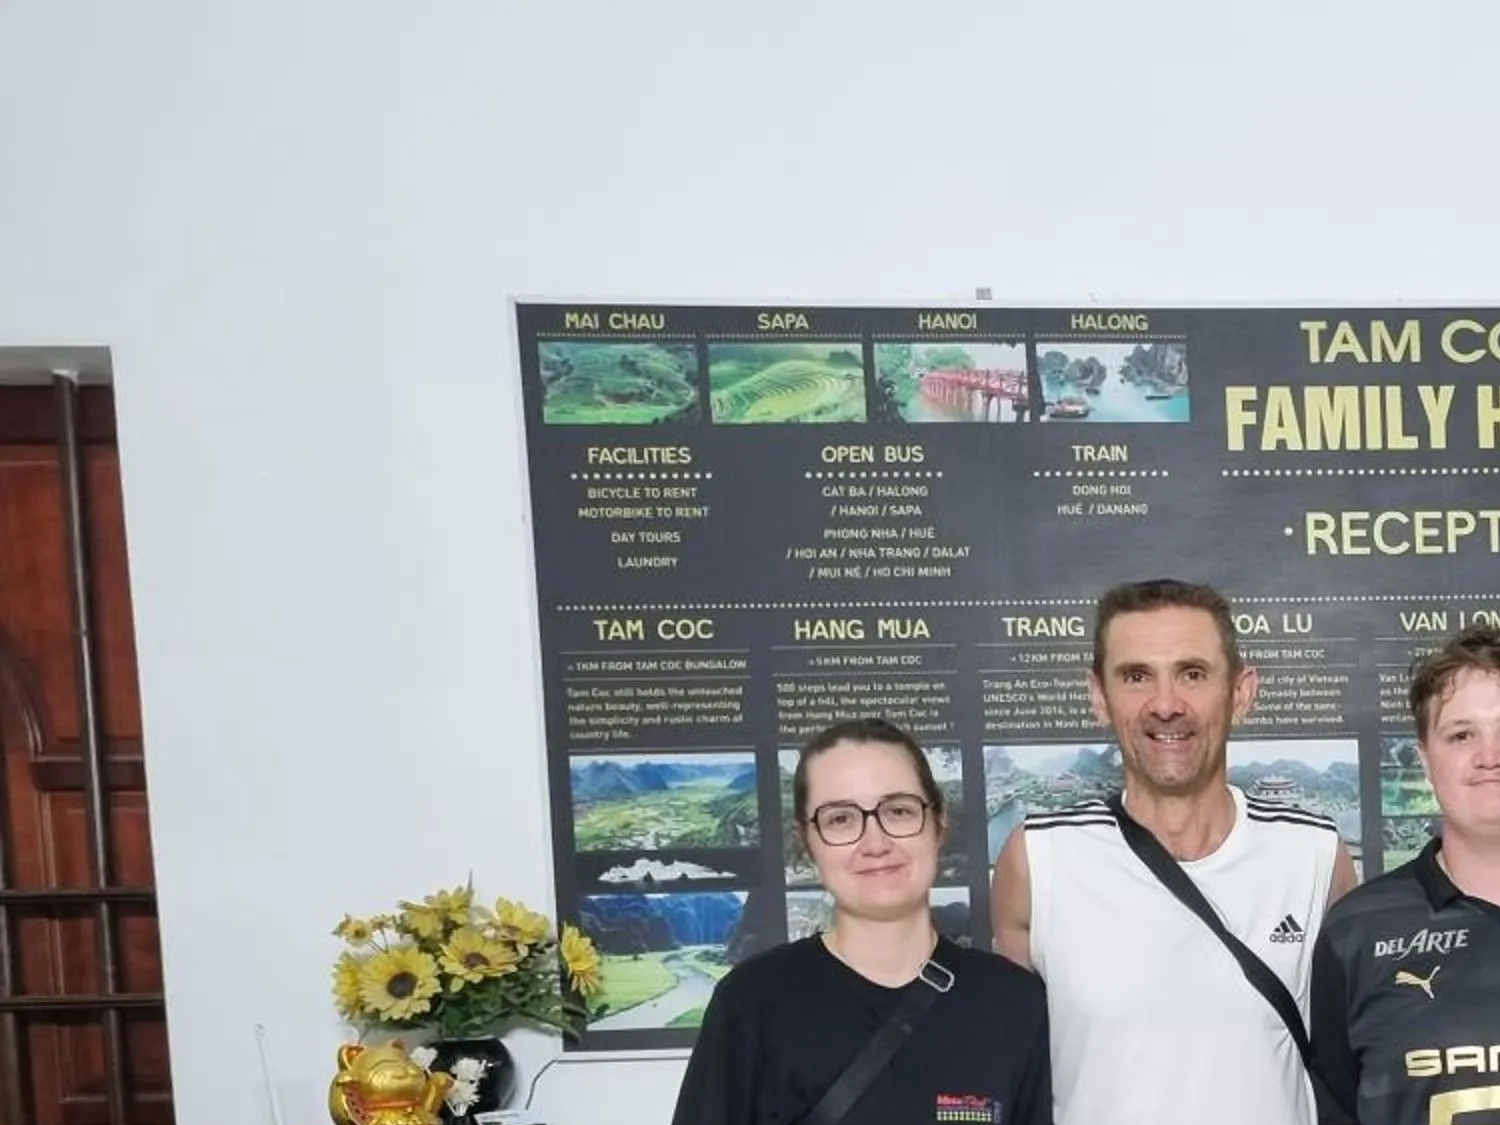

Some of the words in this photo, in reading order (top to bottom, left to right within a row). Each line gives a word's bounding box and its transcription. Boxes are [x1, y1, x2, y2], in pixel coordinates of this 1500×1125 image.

[565, 313, 599, 329] MAI
[609, 313, 665, 329] CHAU
[757, 313, 809, 329] SAPA
[918, 313, 977, 330] HANOI
[1071, 314, 1149, 330] HALONG
[1301, 319, 1421, 363] TAM
[1225, 385, 1455, 451] FAMILY
[587, 447, 692, 464] FACILITIES
[821, 446, 874, 463] OPEN
[884, 445, 924, 463] BUS
[1072, 445, 1128, 462] TRAIN
[587, 487, 641, 499] BICYCLE
[644, 487, 660, 499] TO
[663, 487, 698, 498] RENT
[822, 486, 846, 497] CAT
[850, 486, 866, 497] BA
[877, 486, 928, 497] HALONG
[1072, 485, 1107, 495] DONG
[1110, 485, 1132, 495] HOI
[578, 507, 653, 518] MOTORBIKE
[657, 507, 673, 518] TO
[675, 506, 709, 517] RENT
[839, 505, 878, 516] HANOI
[889, 505, 922, 515] SAPA
[1097, 503, 1149, 515] DANANG
[611, 531, 635, 543] DAY
[640, 531, 681, 543] TOURS
[823, 528, 869, 539] PHONG
[871, 528, 899, 539] NHA
[795, 548, 816, 559] HOI
[819, 548, 837, 559] AN
[849, 548, 876, 558] NHA
[880, 547, 921, 558] TRANG
[931, 547, 971, 557] DALAT
[617, 557, 679, 568] LAUNDRY
[817, 567, 841, 578] MUI
[873, 567, 890, 577] HO
[893, 567, 914, 577] CHI
[917, 566, 951, 577] MINH
[795, 619, 864, 641] HANG
[878, 618, 930, 639] MUA
[1001, 616, 1085, 636] TRANG
[1231, 614, 1271, 634] OA
[1283, 613, 1312, 633] LU
[1400, 611, 1447, 632] VAN
[594, 619, 645, 641] TAM
[658, 619, 713, 640] COC
[876, 655, 898, 665] TAM
[901, 655, 922, 665] COC
